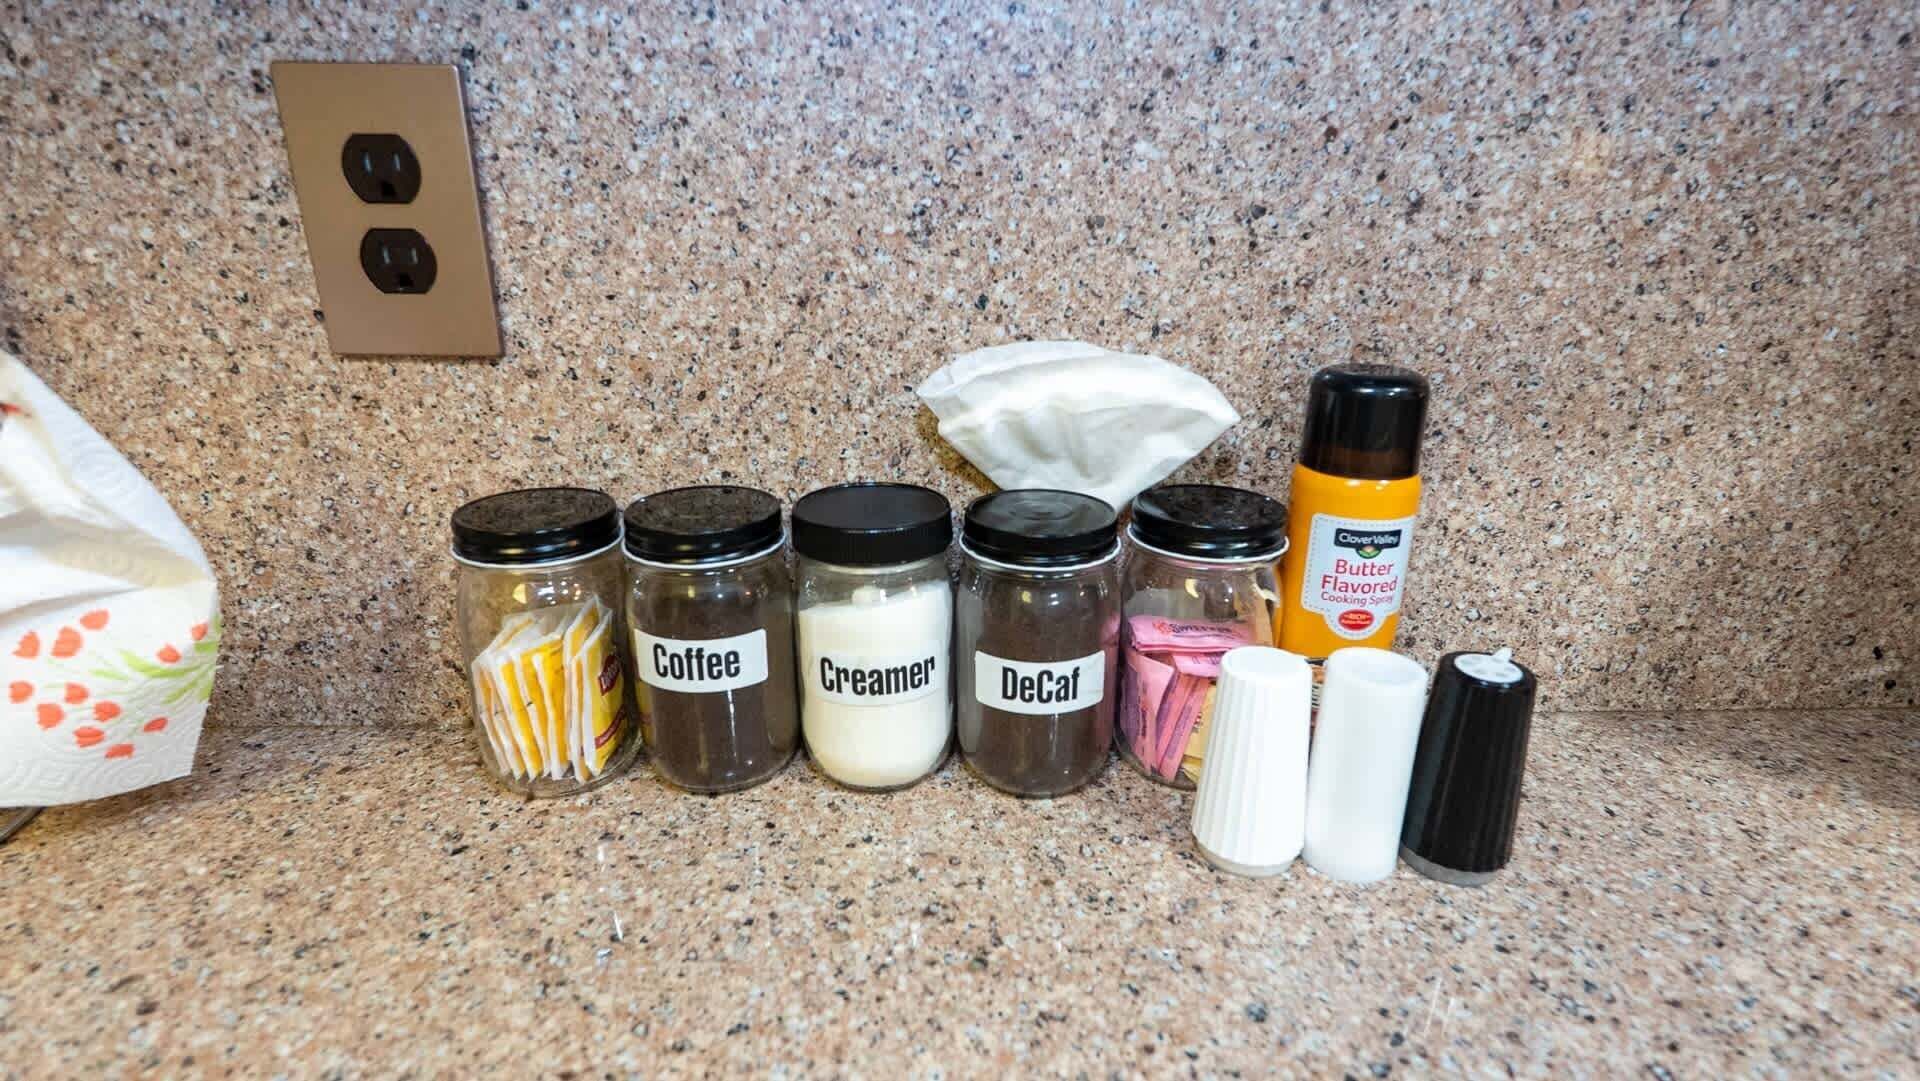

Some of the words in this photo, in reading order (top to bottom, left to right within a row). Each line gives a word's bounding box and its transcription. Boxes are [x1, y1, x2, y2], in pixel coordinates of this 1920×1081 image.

[1335, 559, 1394, 576] Butter
[1321, 574, 1398, 594] Flavored
[1320, 591, 1367, 607] Cooking
[653, 643, 740, 681] Coffee
[820, 656, 935, 696] Creamer
[1001, 666, 1081, 704] DeCaf
